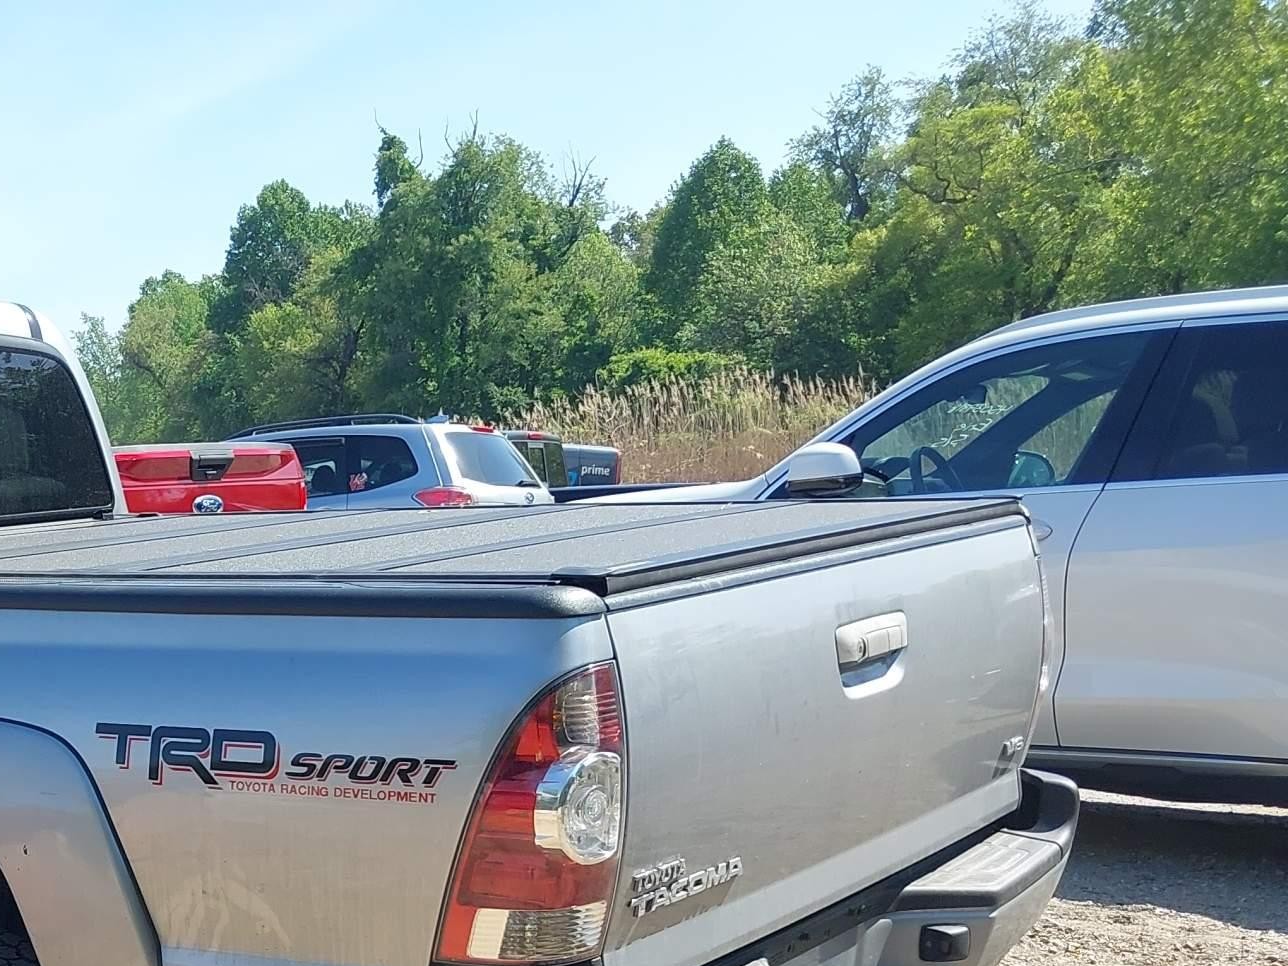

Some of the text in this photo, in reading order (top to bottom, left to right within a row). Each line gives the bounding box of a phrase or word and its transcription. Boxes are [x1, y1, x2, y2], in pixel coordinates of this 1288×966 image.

[581, 463, 610, 477] prime
[95, 722, 458, 790] TRD SPORT
[1002, 735, 1024, 756] V6
[229, 780, 437, 804] TOYOTA RACING DEVELOPMENT
[630, 857, 743, 918] TACOMA
[631, 857, 687, 893] TOYOTA
